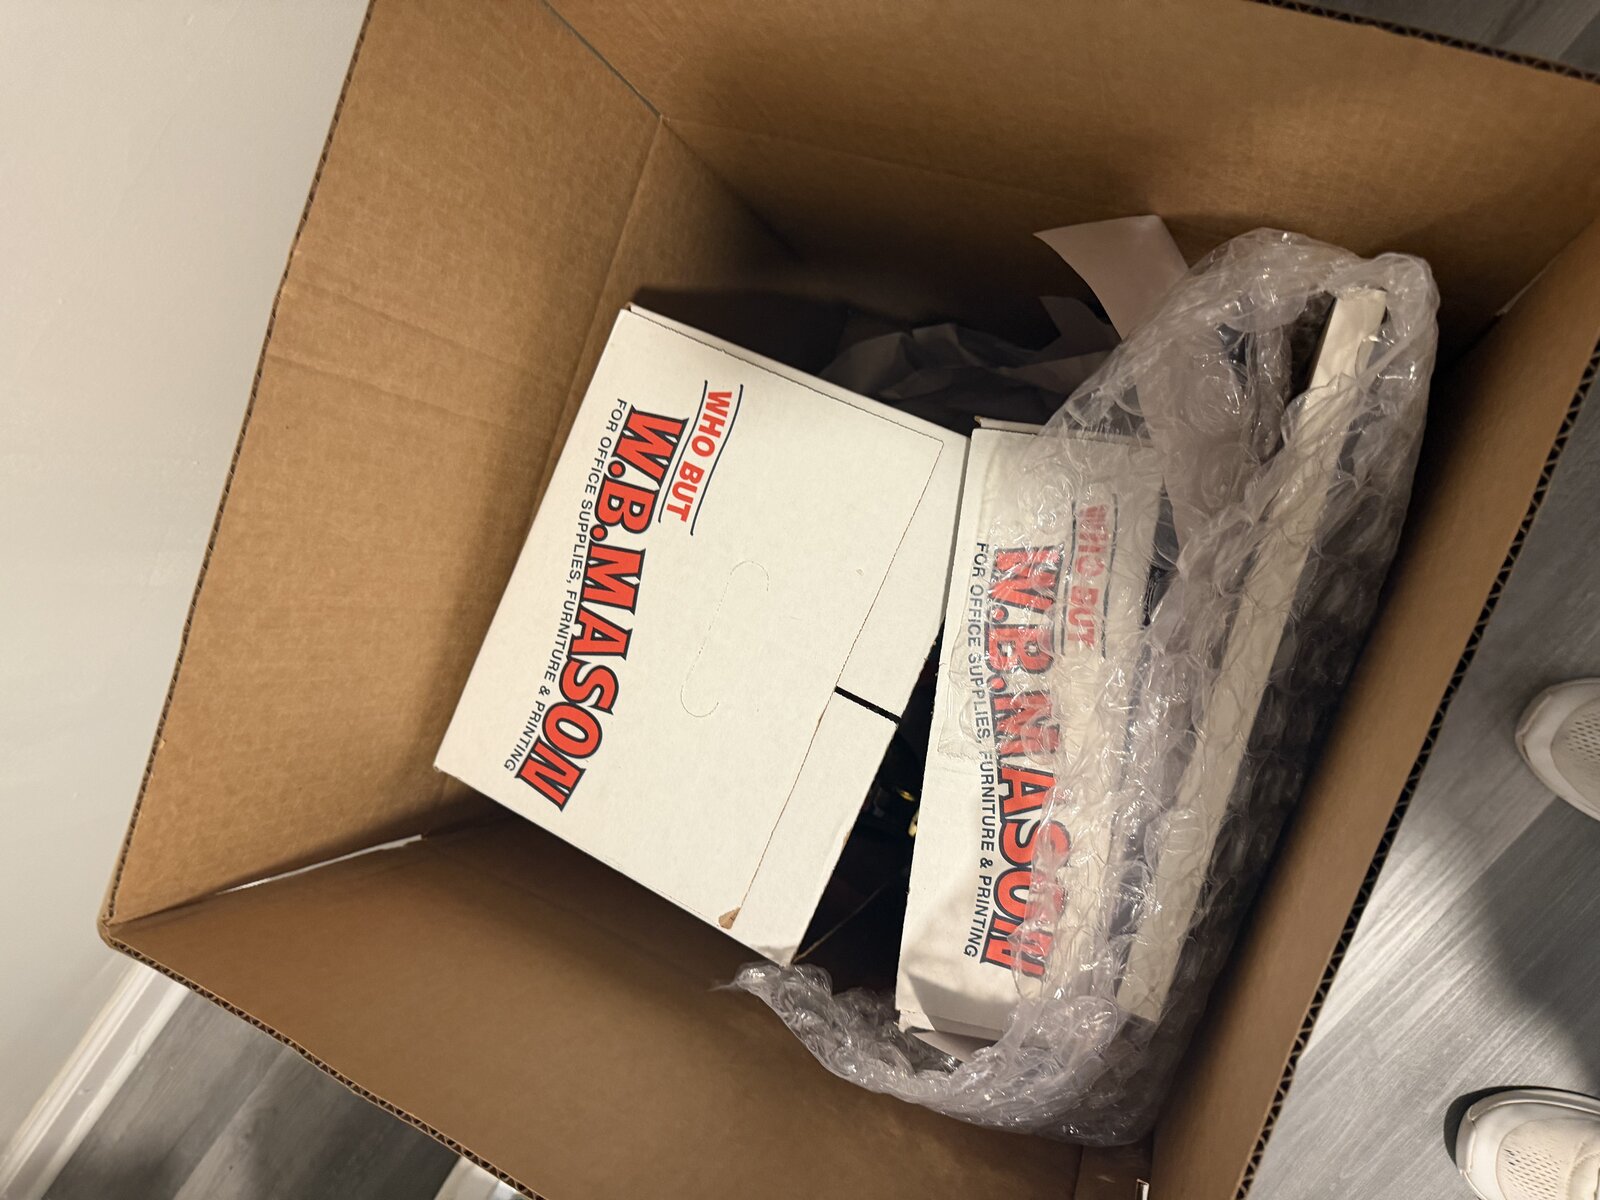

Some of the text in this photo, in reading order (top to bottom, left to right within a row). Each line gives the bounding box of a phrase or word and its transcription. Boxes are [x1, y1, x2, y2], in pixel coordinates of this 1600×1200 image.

[666, 391, 732, 522] WHO BUT
[504, 398, 627, 772] FOR OFFICE SUPPLIES, FURNITURE & PRINTING
[971, 542, 989, 578] FOR
[514, 404, 689, 812] W.B.MASON
[967, 584, 985, 647] OFFICE
[1067, 585, 1100, 648] BUT
[979, 751, 996, 852] FURNITURE
[979, 857, 994, 869] &
[964, 874, 993, 958] PRINTING
